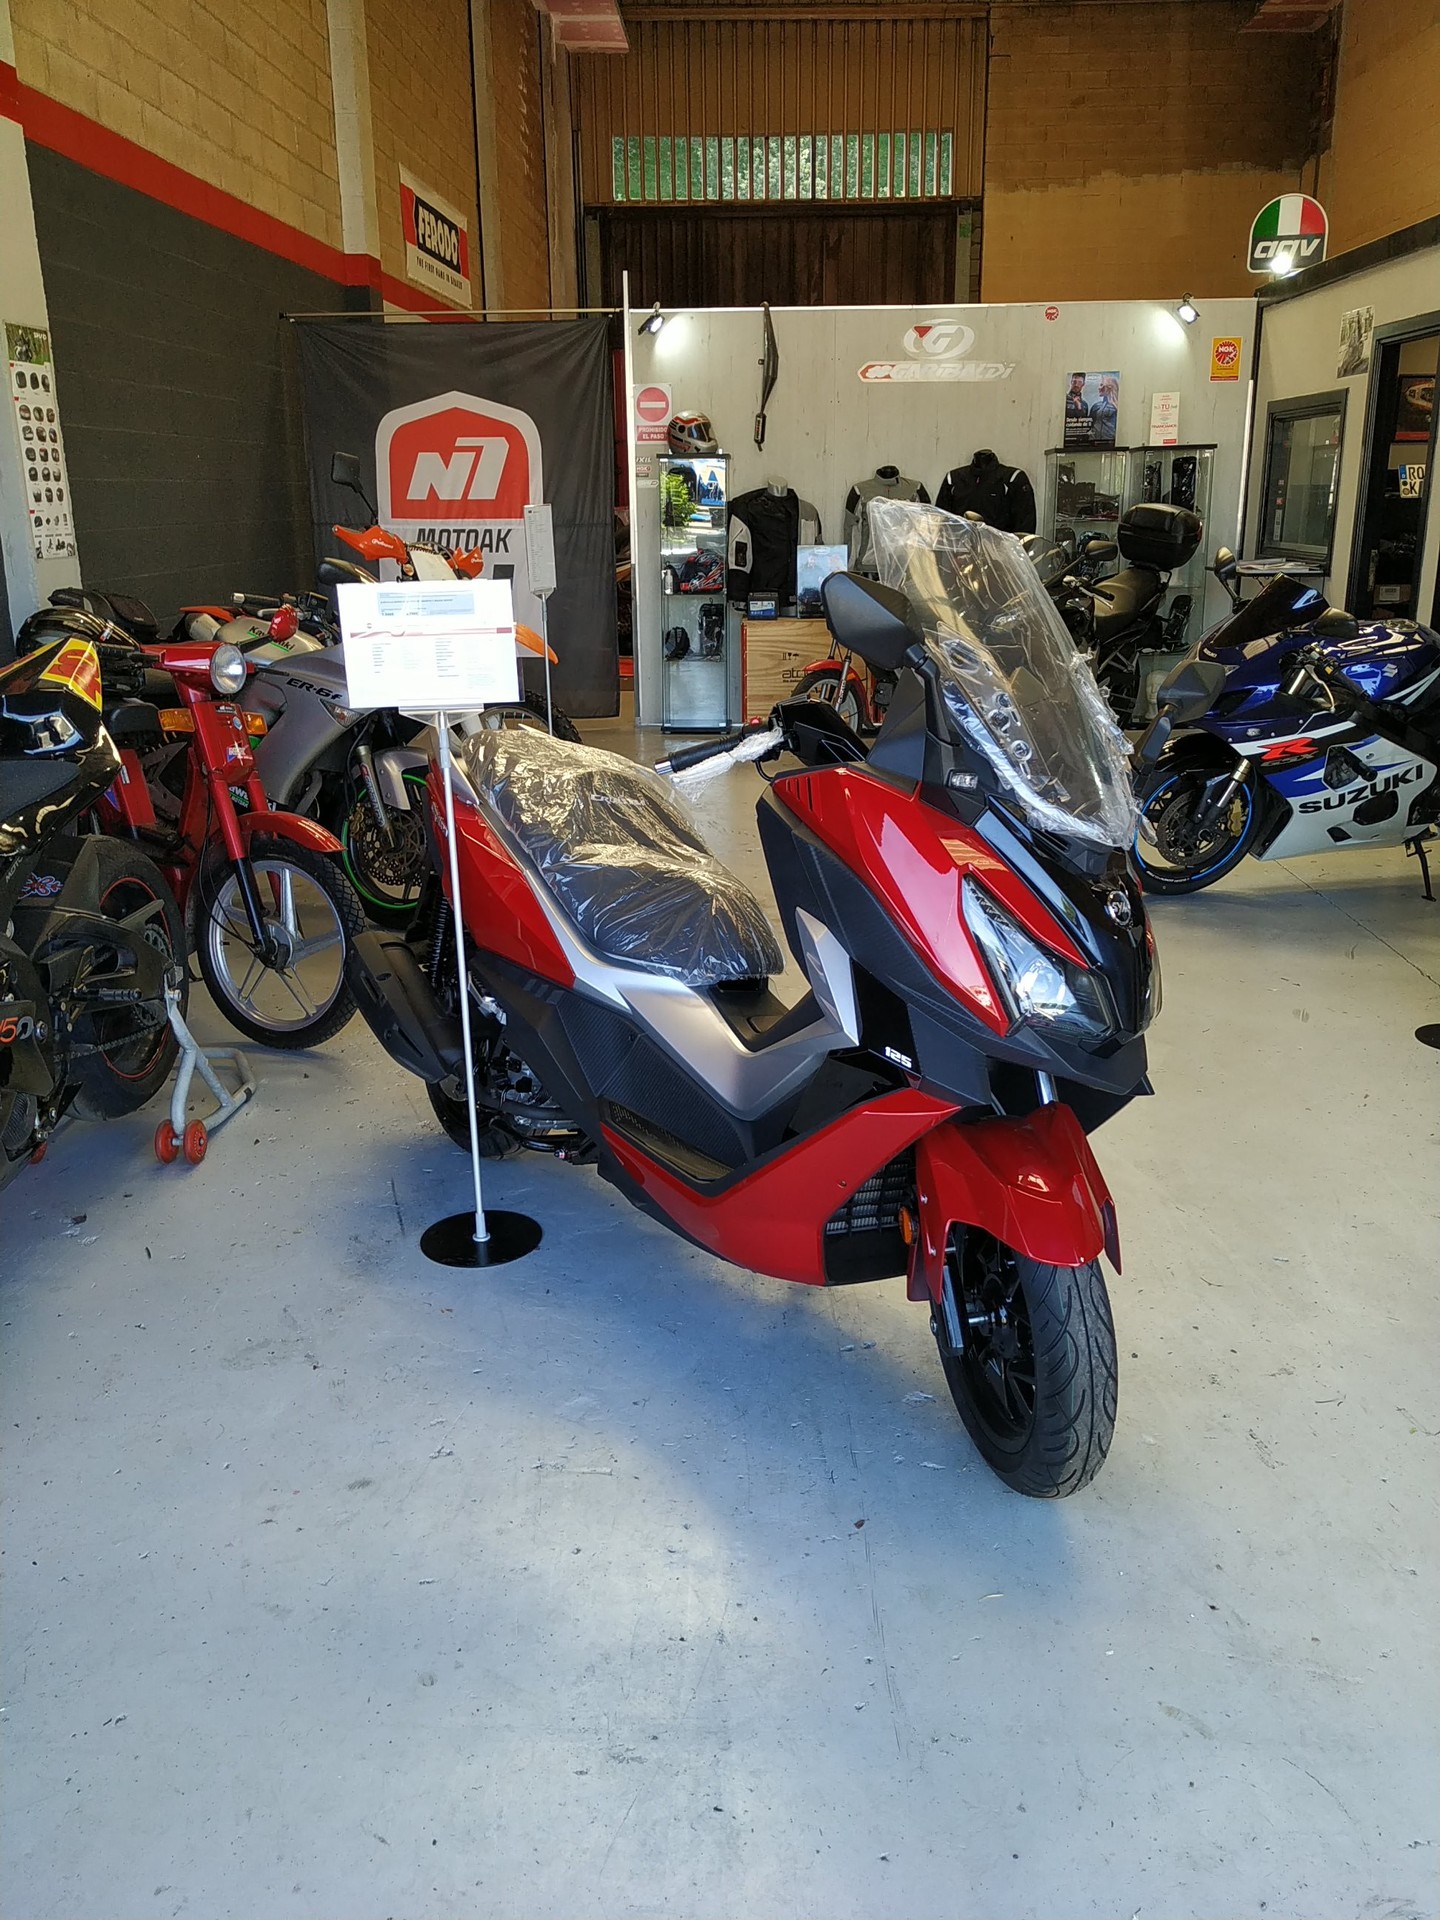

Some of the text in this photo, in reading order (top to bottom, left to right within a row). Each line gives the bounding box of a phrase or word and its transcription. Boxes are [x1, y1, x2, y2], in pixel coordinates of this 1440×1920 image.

[418, 205, 458, 266] FERODO
[417, 528, 513, 553] MOTOAK
[1298, 764, 1424, 815] SUZUKI
[885, 1046, 912, 1068] 125
